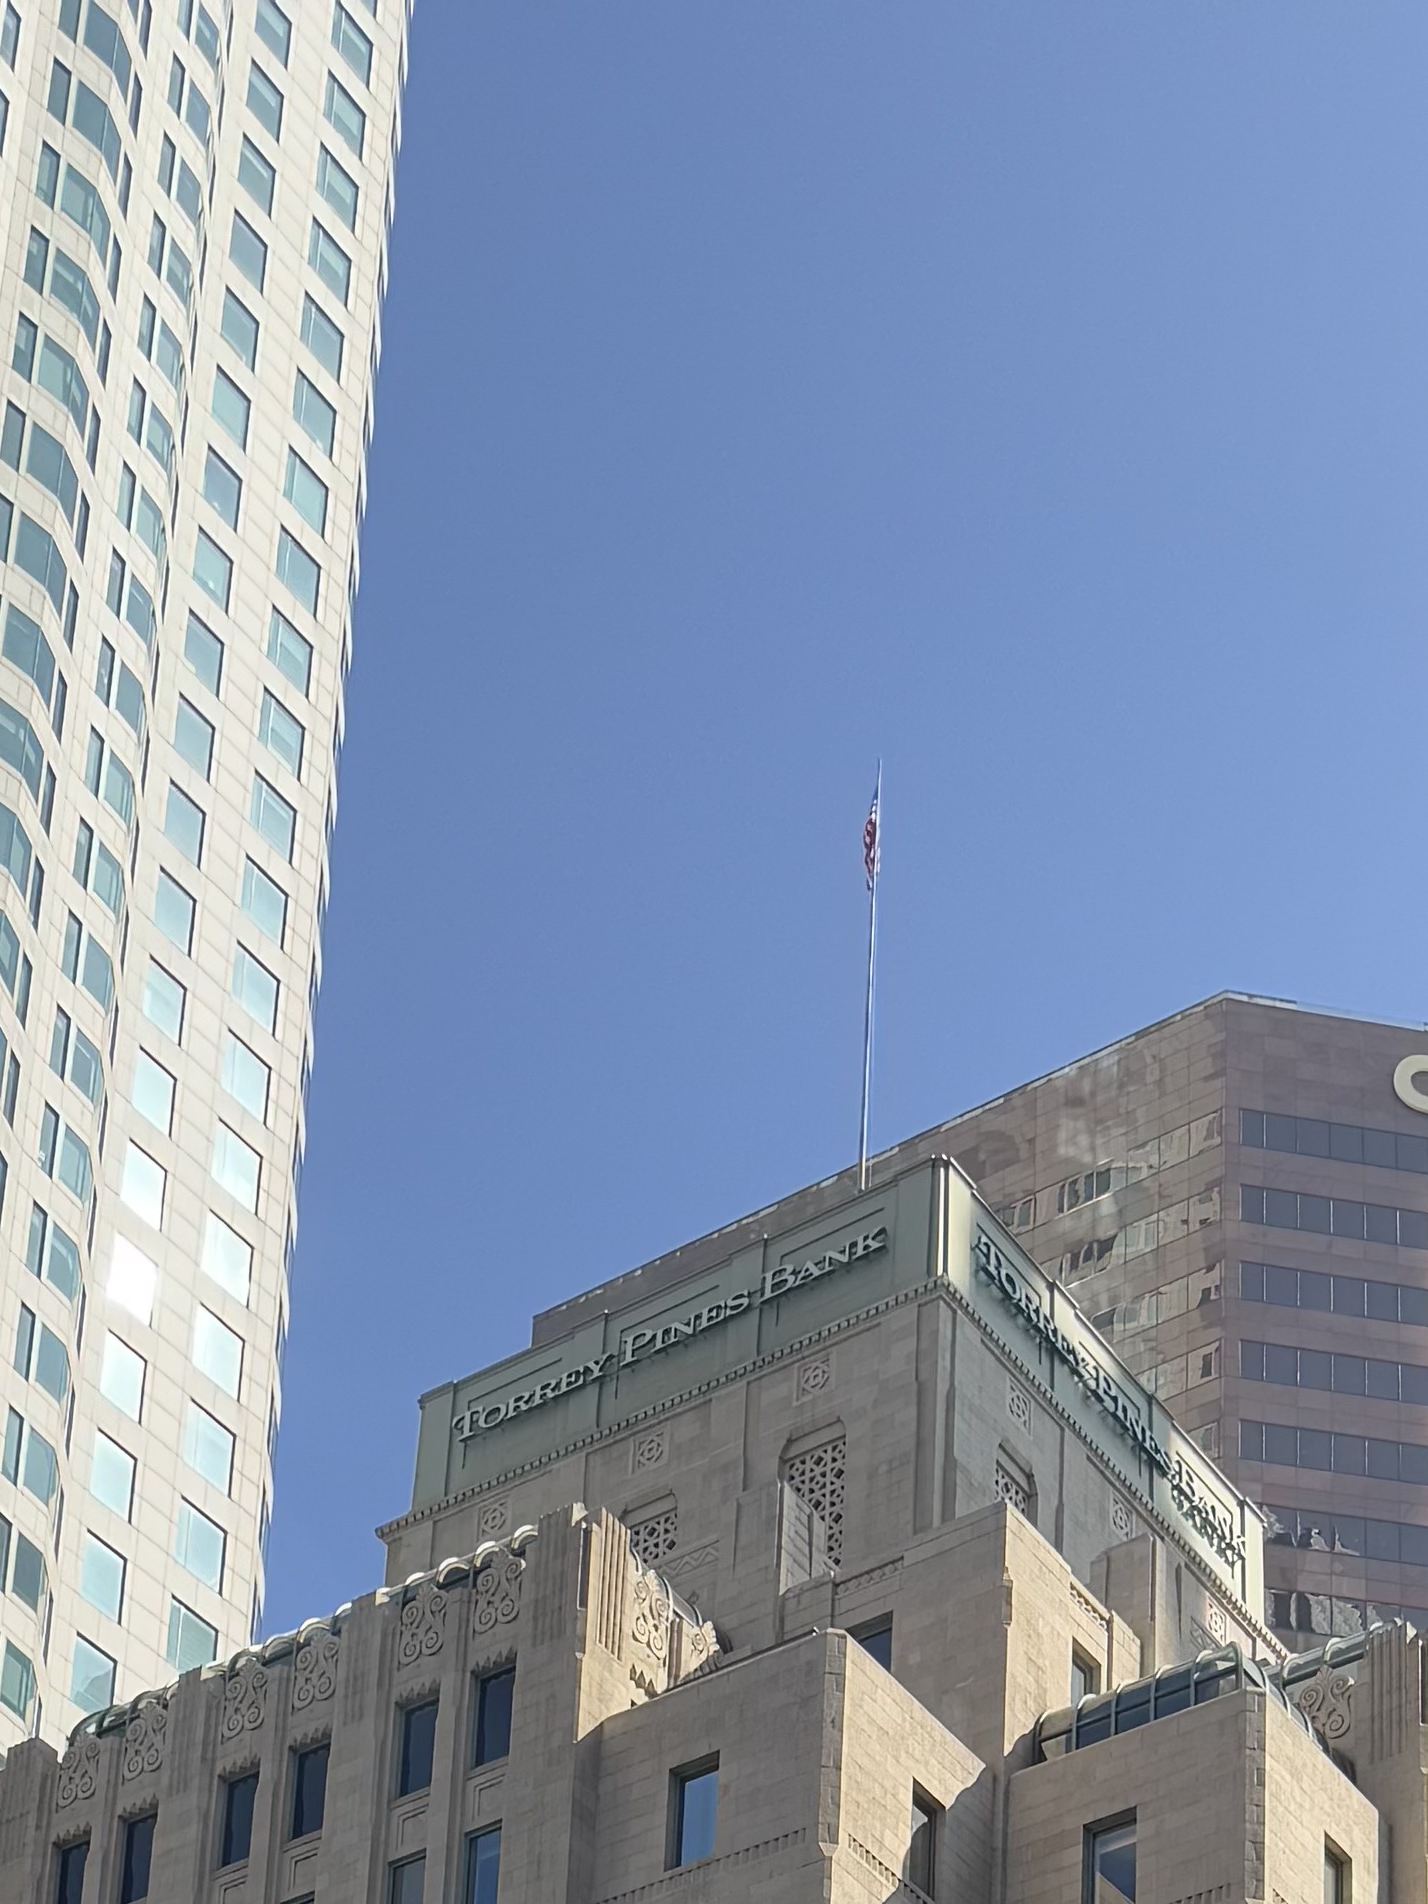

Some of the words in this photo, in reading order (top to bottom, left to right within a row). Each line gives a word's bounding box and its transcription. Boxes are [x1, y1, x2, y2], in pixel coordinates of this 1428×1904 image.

[452, 1352, 617, 1443] TORREY
[619, 1289, 752, 1366] PINES
[759, 1226, 888, 1302] BANK
